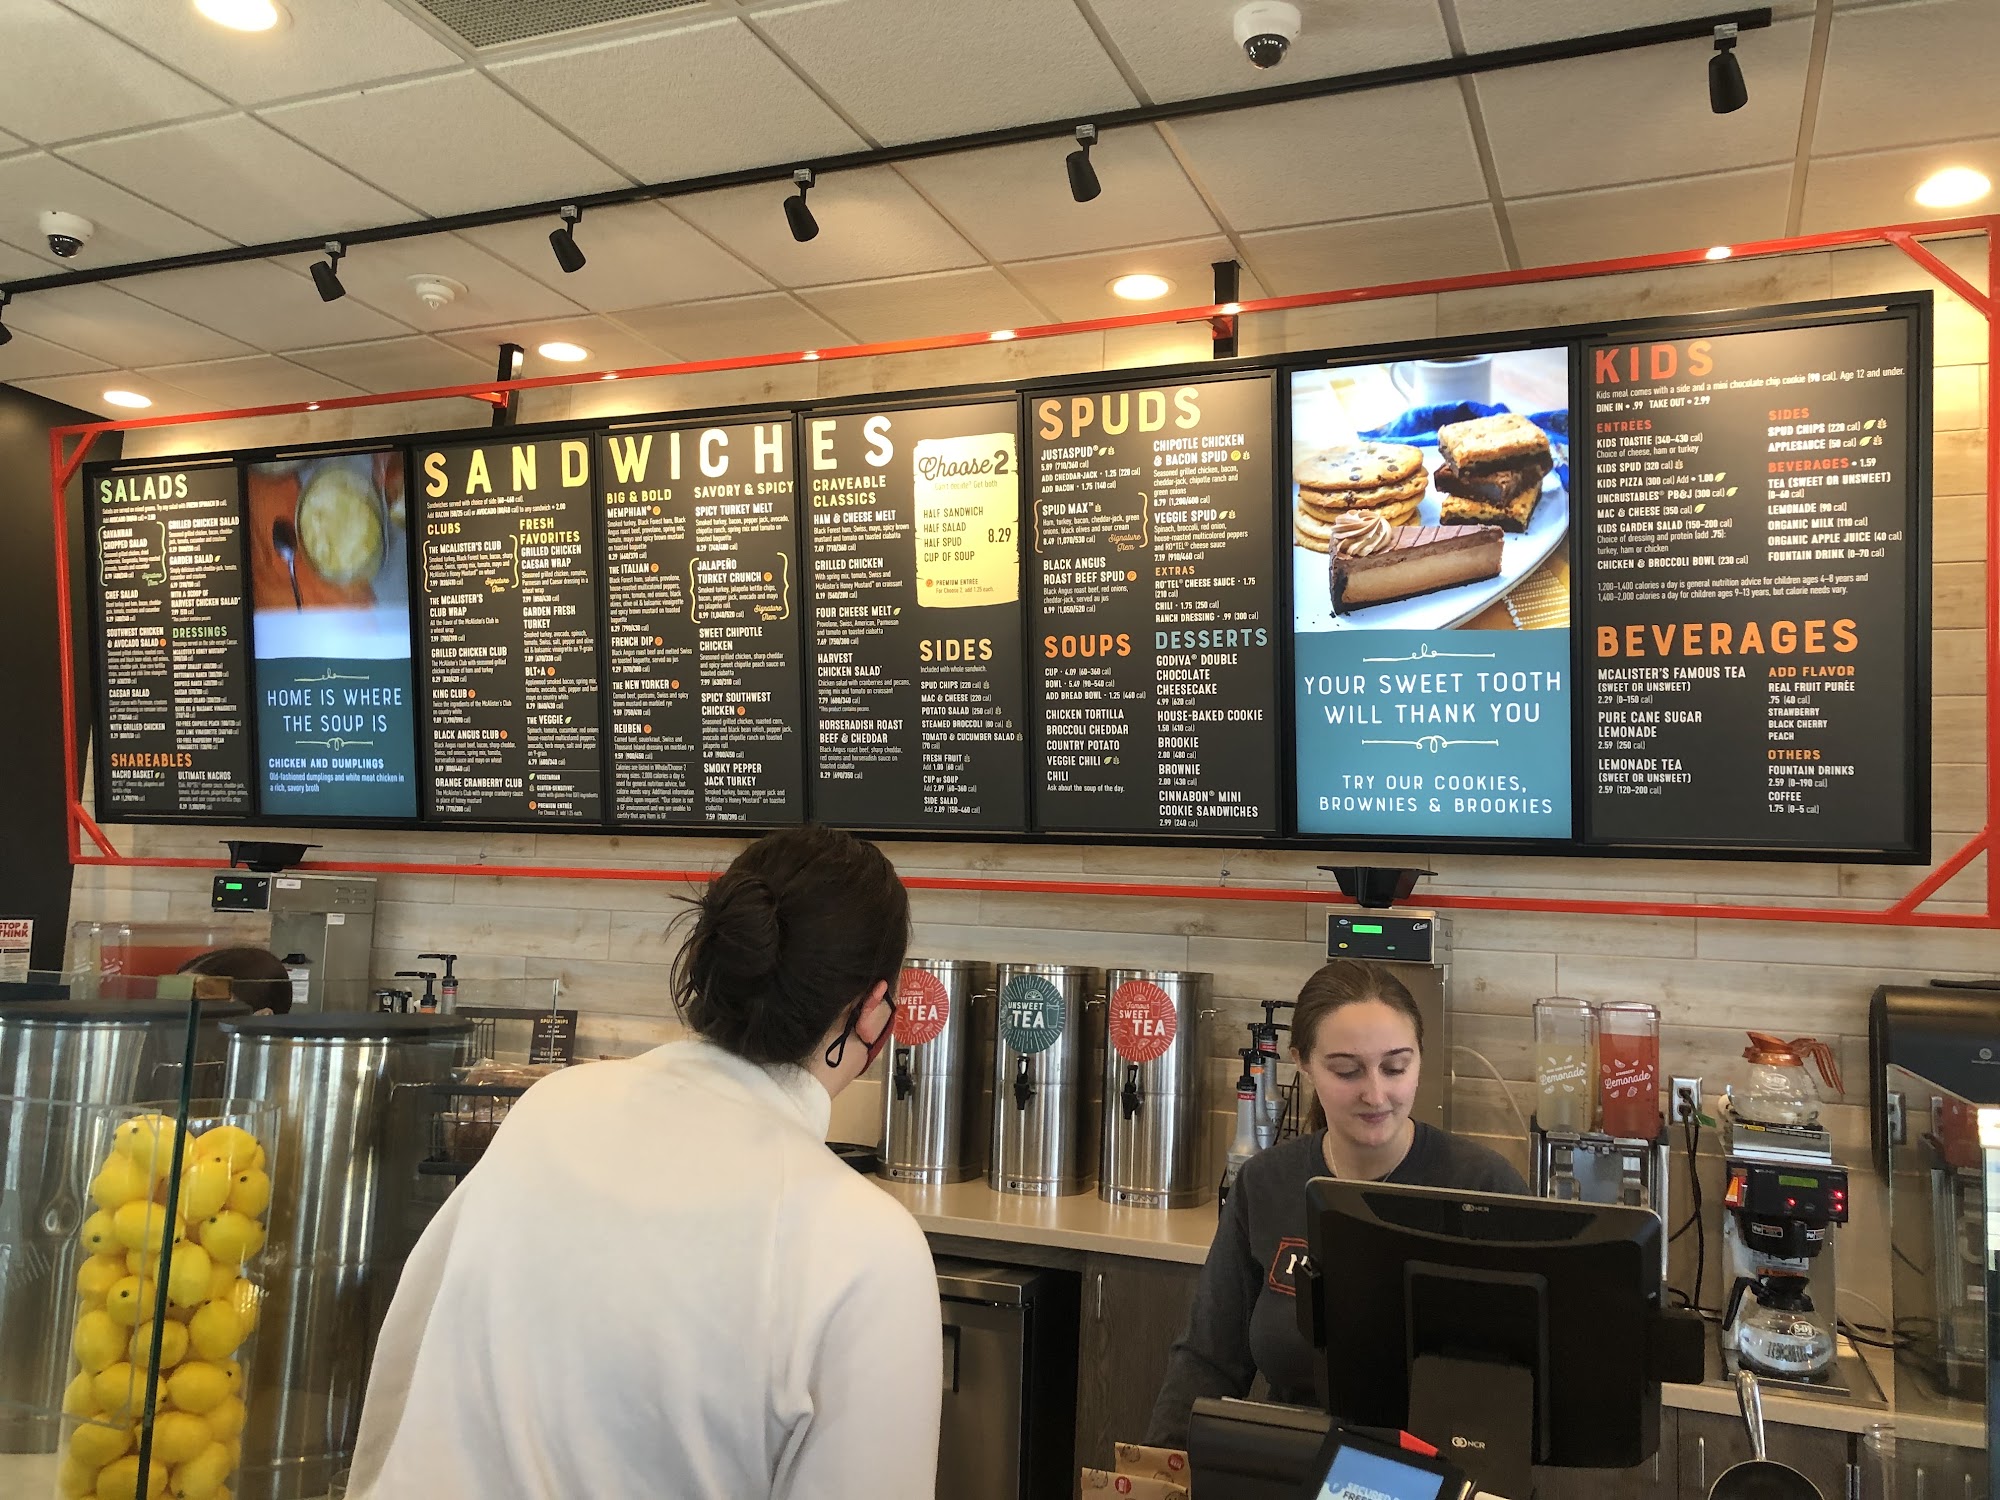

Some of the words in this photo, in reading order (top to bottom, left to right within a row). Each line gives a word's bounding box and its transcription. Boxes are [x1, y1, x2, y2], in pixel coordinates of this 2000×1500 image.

[1595, 341, 1713, 384] KIDS
[1840, 370, 1854, 380] Age
[1856, 369, 1864, 379] 12
[1867, 368, 1880, 378] and
[1883, 366, 1905, 377] under.
[1038, 387, 1201, 440] SPUDS
[1768, 408, 1809, 421] SIDES
[1597, 420, 1652, 433] ENTRÉES
[1768, 458, 1849, 473] BEVERAGES
[1860, 458, 1876, 468] 1.59
[100, 474, 187, 503] SALADS
[813, 475, 886, 491] CRAVEABLE
[694, 484, 740, 499] SAVORY
[745, 483, 754, 496] &
[758, 481, 794, 495] SPICY
[607, 493, 625, 504] BIG
[630, 491, 638, 503] &
[642, 489, 671, 502] BOLD
[813, 492, 876, 507] CLASSICS
[924, 509, 940, 518] HALF
[944, 507, 983, 518] SANDWICH
[1768, 503, 1816, 515] LEMONADE
[1154, 511, 1187, 524] VEGGIE
[1190, 509, 1217, 522] SPUD
[428, 523, 461, 535] CLUBS
[520, 518, 554, 530] FRESH
[924, 523, 939, 533] HALF
[942, 522, 966, 532] SALAD
[520, 531, 580, 544] FAVORITES
[988, 528, 1011, 543] 8.29
[924, 538, 940, 548] HALF
[942, 537, 961, 546] SPUD
[924, 552, 939, 562] CUP
[942, 552, 951, 561] OF
[955, 552, 974, 561] SOUP
[1155, 566, 1195, 577] EXTRAS
[105, 591, 119, 599] CHEF
[120, 590, 138, 598] SALAD
[172, 626, 227, 638] DRESSINGS
[1597, 619, 1858, 657] BEVERAGES
[612, 637, 638, 646] FRENCH
[642, 636, 653, 646] DIP
[1155, 628, 1268, 650] DESSERTS
[920, 639, 993, 662] SIDES
[1044, 633, 1131, 659] SOUPS
[1157, 669, 1210, 681] CHOCOLATE
[1673, 667, 1720, 679] FAMOUS
[1724, 666, 1746, 679] TEA
[1769, 667, 1796, 678] ADD
[1803, 665, 1855, 677] FLAVOR
[1304, 675, 1365, 694] YOUR
[1379, 674, 1463, 693] SWEET
[1477, 671, 1561, 692] TOOTH
[1598, 682, 1629, 693] (SWEET
[1632, 682, 1643, 692] OR
[1647, 681, 1691, 692] UNSWEET)
[1768, 682, 1791, 693] REAL
[1794, 682, 1822, 692] FRUIT
[1825, 680, 1855, 692] PURÉE
[109, 690, 130, 698] CAESAR
[132, 689, 149, 697] SALAD
[433, 690, 448, 698] KING
[450, 689, 467, 698] CLUB
[1157, 684, 1217, 696] CHEESECAKE
[268, 689, 311, 706] HOME
[321, 689, 334, 705] IS
[344, 688, 402, 705] WHERE
[1598, 695, 1613, 704] 2.29
[1046, 710, 1082, 720] CHICKEN
[1085, 709, 1124, 719] TORTILLA
[1157, 710, 1224, 721] HOUSE-BAKED
[1228, 710, 1263, 721] COOKIE
[1325, 705, 1382, 724] WILL
[1395, 704, 1475, 723] THANK
[1490, 703, 1540, 723] YOU
[1598, 712, 1626, 723] PURE
[1631, 711, 1660, 723] CANE
[1665, 711, 1702, 723] SUGAR
[1768, 706, 1819, 717] STRAWBERRY
[283, 716, 312, 732] THE
[321, 715, 363, 732] SOUP
[373, 715, 387, 732] IS
[614, 724, 641, 733] REUBEN
[1047, 725, 1086, 735] BROCCOLI
[1089, 724, 1128, 735] CHEDDAR
[1768, 719, 1794, 729] BLACK
[1797, 719, 1827, 728] CHERRY
[1598, 726, 1657, 738] LEMONADE
[1768, 731, 1794, 741] PEACH
[1047, 740, 1084, 750] COUNTRY
[1087, 740, 1119, 750] POTATO
[1158, 737, 1198, 748] BROOKIE
[1598, 741, 1613, 750] 2.59
[111, 753, 192, 767] SHAREABLES
[1047, 756, 1076, 766] VEGGIE
[1079, 756, 1100, 766] CHILI
[1768, 750, 1820, 760] OTHERS
[269, 759, 306, 768] CHICKEN
[311, 759, 328, 768] AND
[332, 759, 384, 769] DUMPLINGS
[704, 764, 731, 773] SMOKY
[733, 764, 762, 773] PEPPER
[1158, 764, 1200, 775] BROWNIE
[1599, 759, 1657, 771] LEMONADE
[1662, 759, 1682, 771] TEA
[132, 770, 153, 778] BASKET
[178, 772, 205, 780] ULTIMATE
[207, 772, 231, 780] NACHOS
[1047, 771, 1069, 781] CHILI
[1768, 765, 1815, 776] FOUNTAIN
[1818, 765, 1854, 776] DRINKS
[436, 778, 462, 787] ORANGE
[464, 778, 502, 787] CRANBERRY
[505, 778, 522, 787] CLUB
[704, 776, 724, 786] JACK
[727, 776, 756, 786] TURKEY
[1342, 775, 1374, 789] TRY
[1386, 775, 1423, 790] OUR
[1435, 776, 1527, 793] COOKIES,
[275, 784, 286, 792] rich,
[288, 785, 304, 793] savory
[306, 784, 319, 792] broth
[1768, 791, 1801, 802] COFFEE
[1320, 797, 1418, 812] BROWNIES
[1429, 798, 1441, 812] &
[1455, 798, 1552, 813] BROOKIES
[1768, 805, 1784, 813] 1.75
[1008, 1002, 1043, 1010] UNSWEET
[908, 1005, 938, 1021] TEA
[1012, 1010, 1044, 1028] TEA
[1120, 1010, 1149, 1019] SWEET
[1132, 1019, 1166, 1036] TEA
[1540, 1067, 1585, 1085] Lemonade
[1605, 1071, 1651, 1089] Lemonade
[1468, 1441, 1486, 1449] NCR
